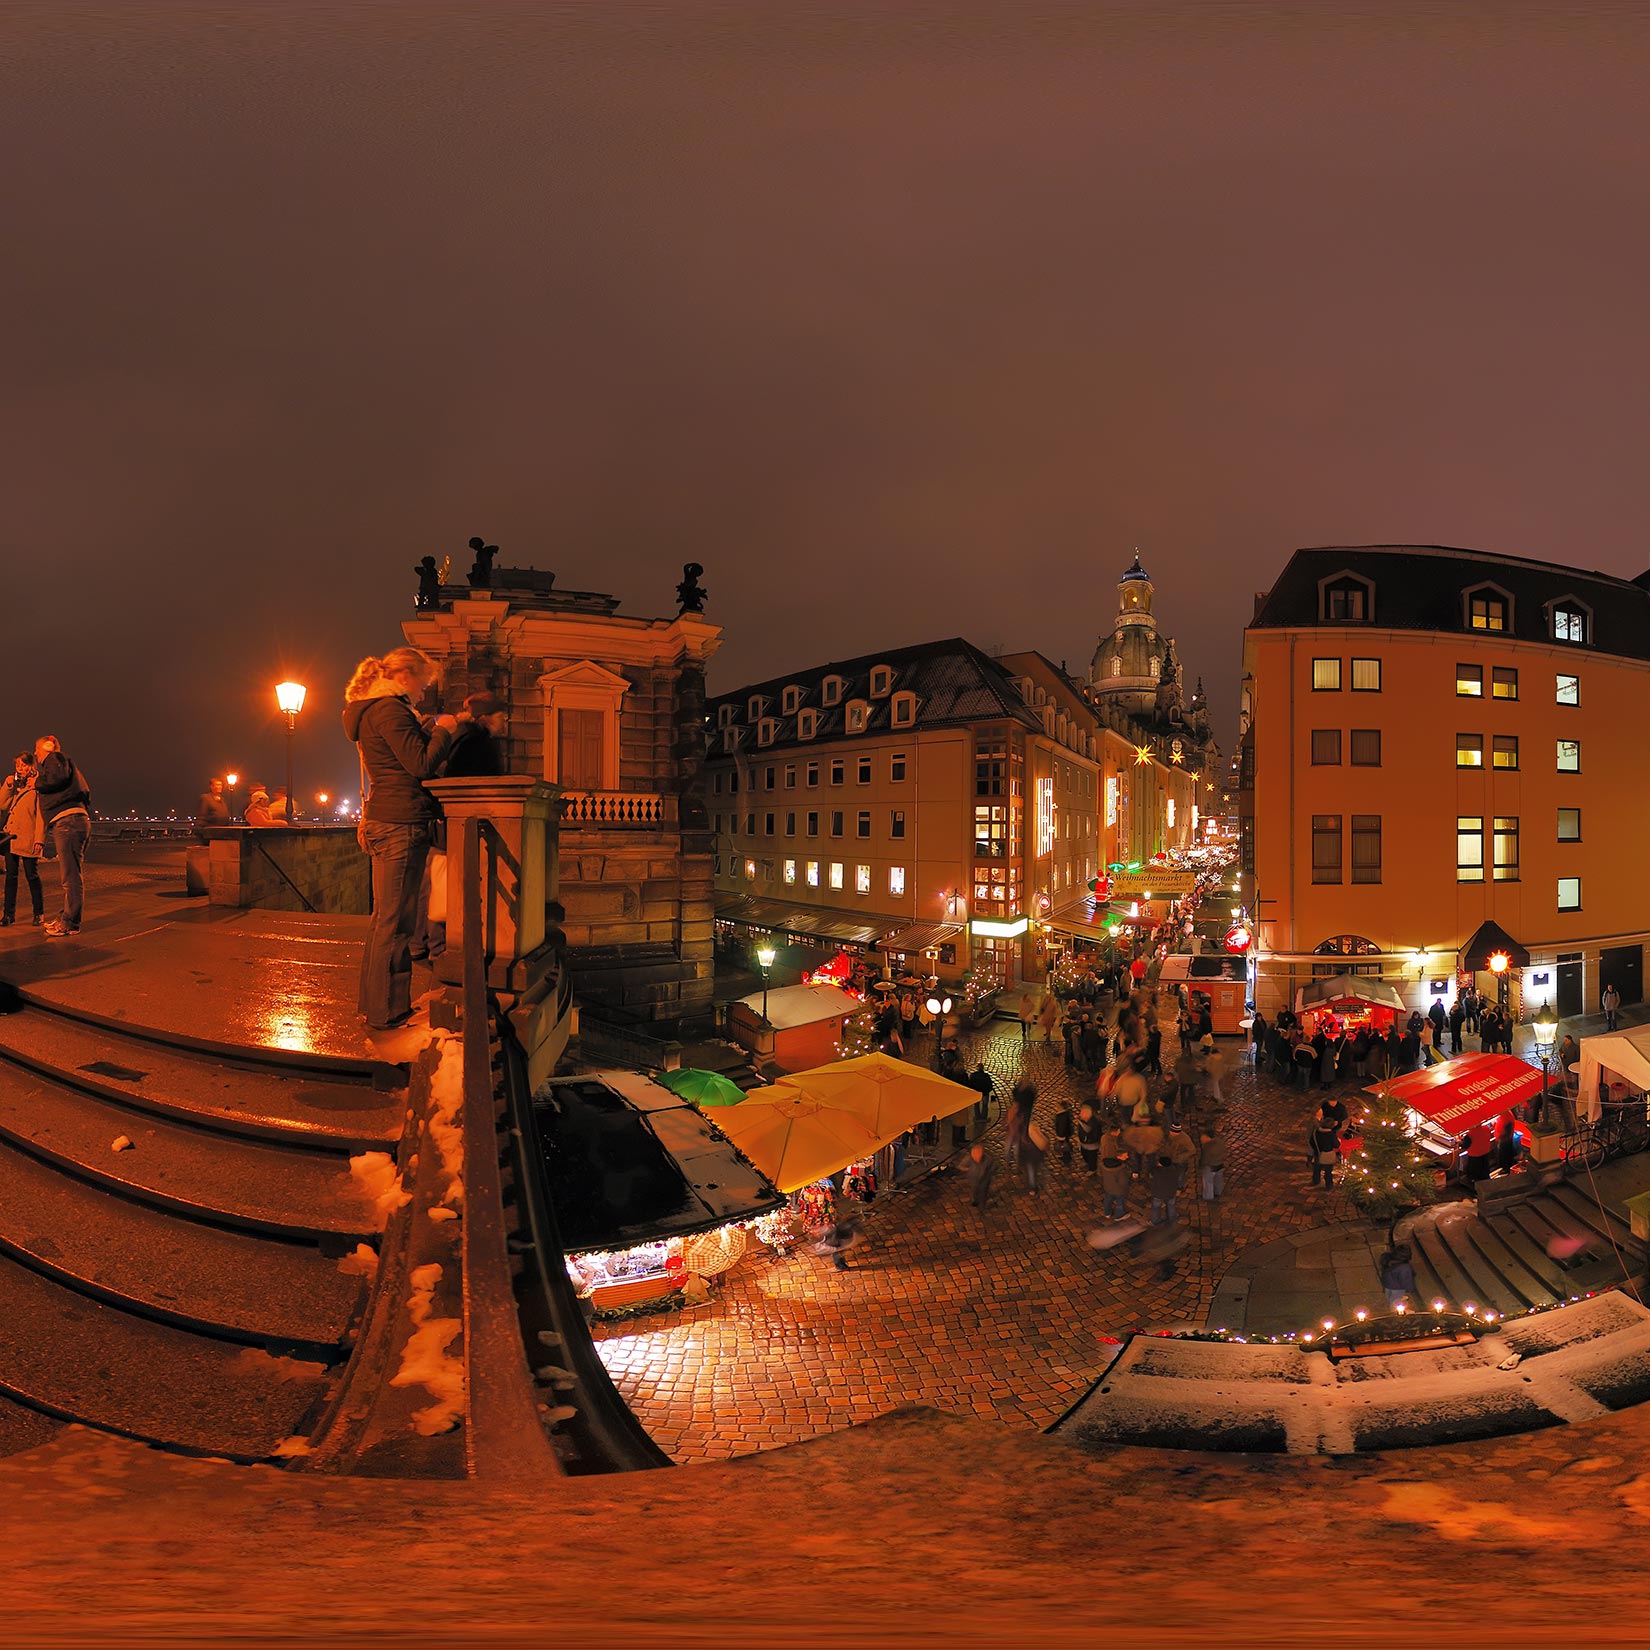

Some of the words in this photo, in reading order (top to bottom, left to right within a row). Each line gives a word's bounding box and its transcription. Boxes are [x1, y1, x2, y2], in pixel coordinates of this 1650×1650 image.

[1115, 873, 1183, 882] Weihnachtsmarkt
[1457, 1075, 1500, 1096] Original
[1431, 1097, 1487, 1123] Thüringer
